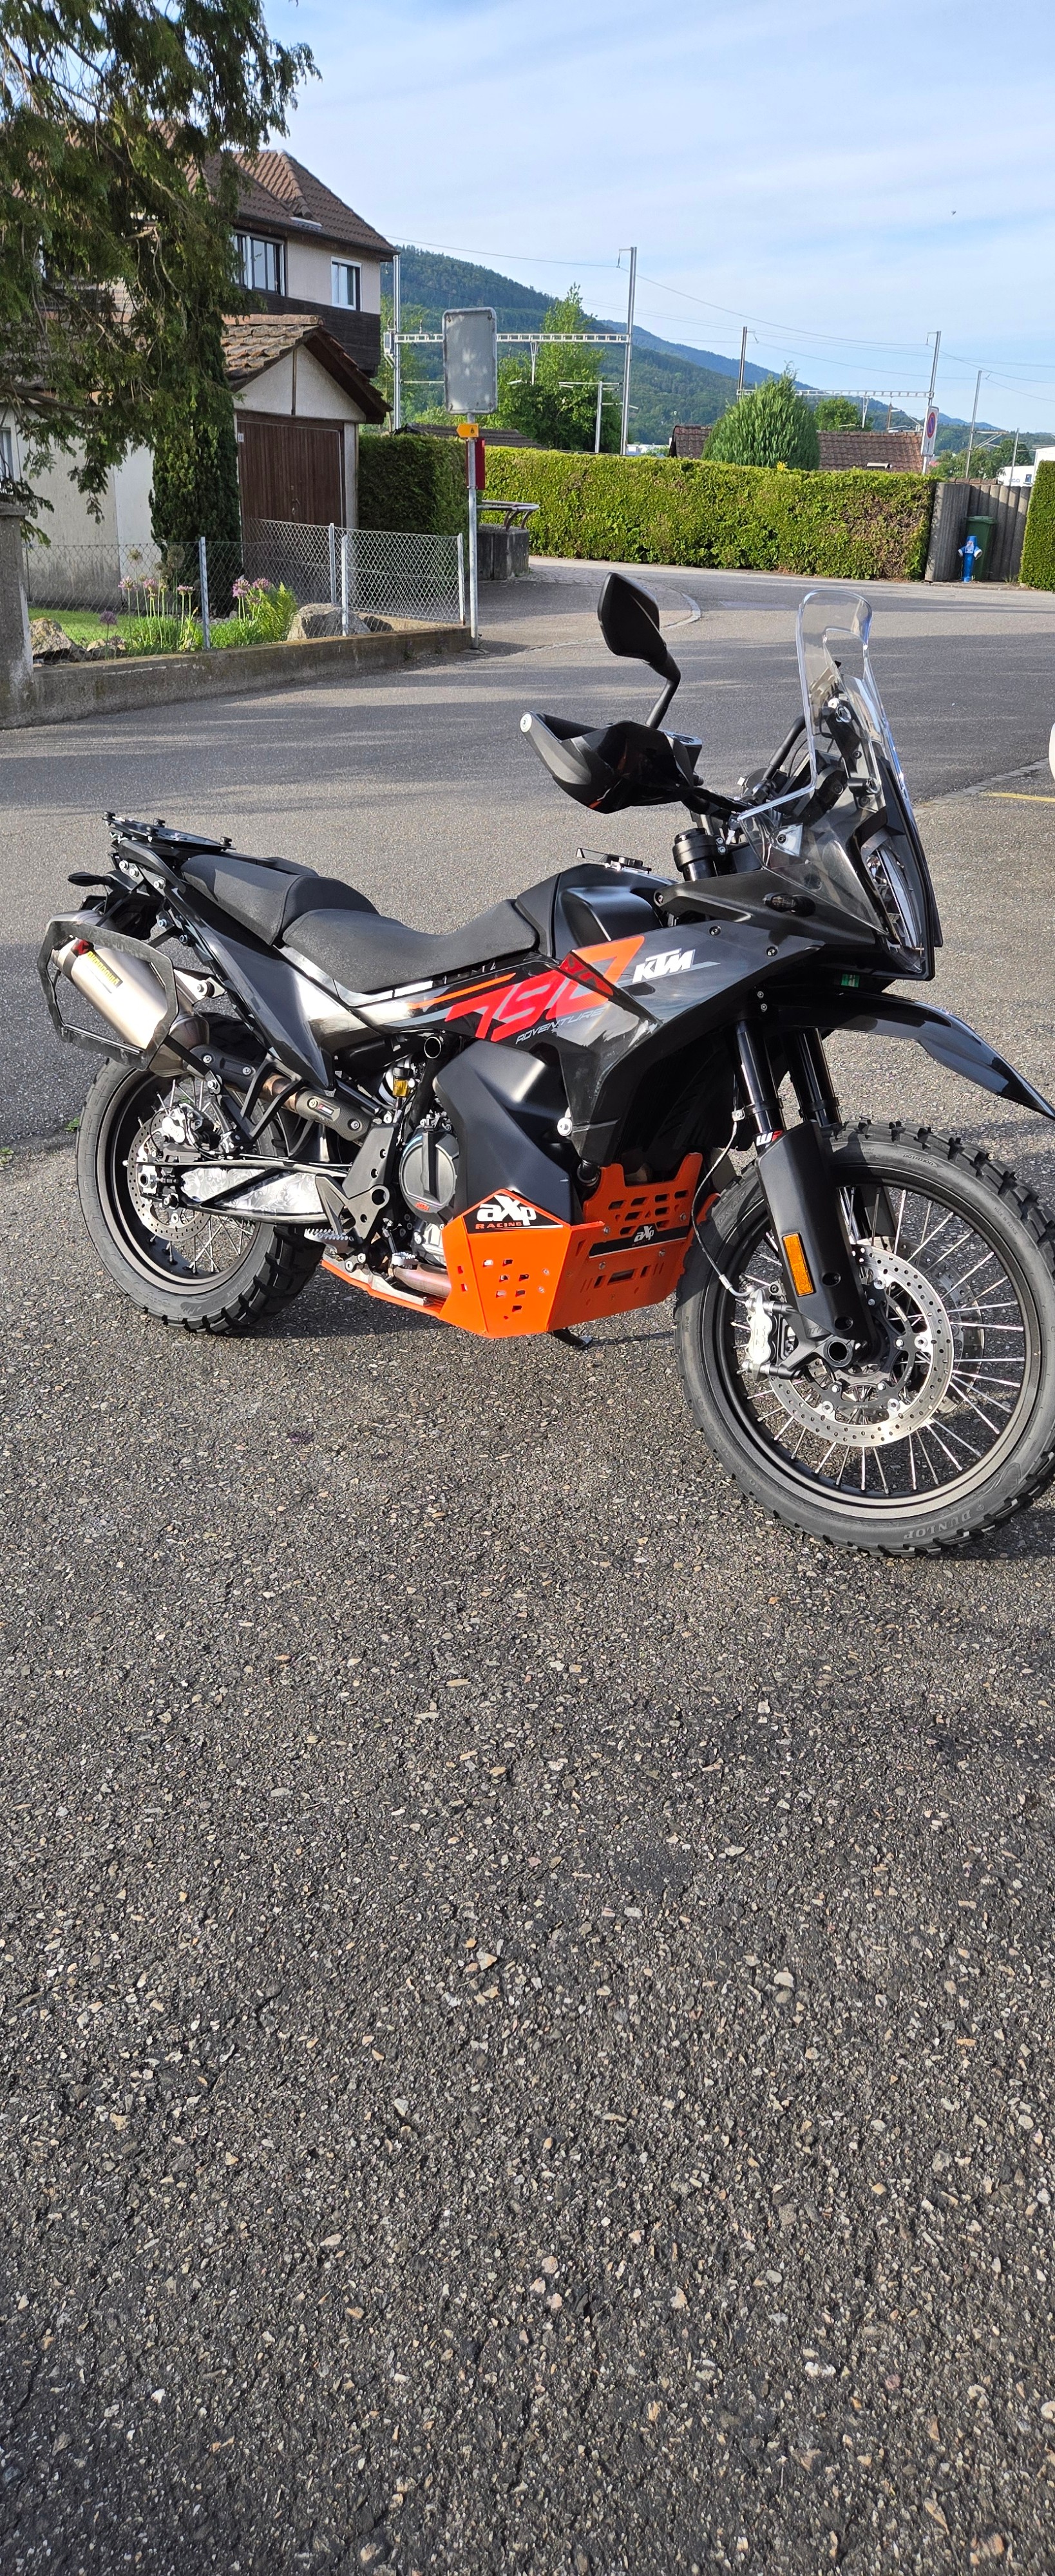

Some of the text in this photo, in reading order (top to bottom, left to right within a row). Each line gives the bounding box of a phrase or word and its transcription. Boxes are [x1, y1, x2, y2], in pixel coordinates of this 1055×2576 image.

[632, 948, 696, 983] KTM
[444, 936, 645, 1042] 790
[516, 1007, 607, 1045] ADVENTURE
[903, 1153, 934, 1166] ROTATION
[904, 1510, 971, 1539] DUNLOP
